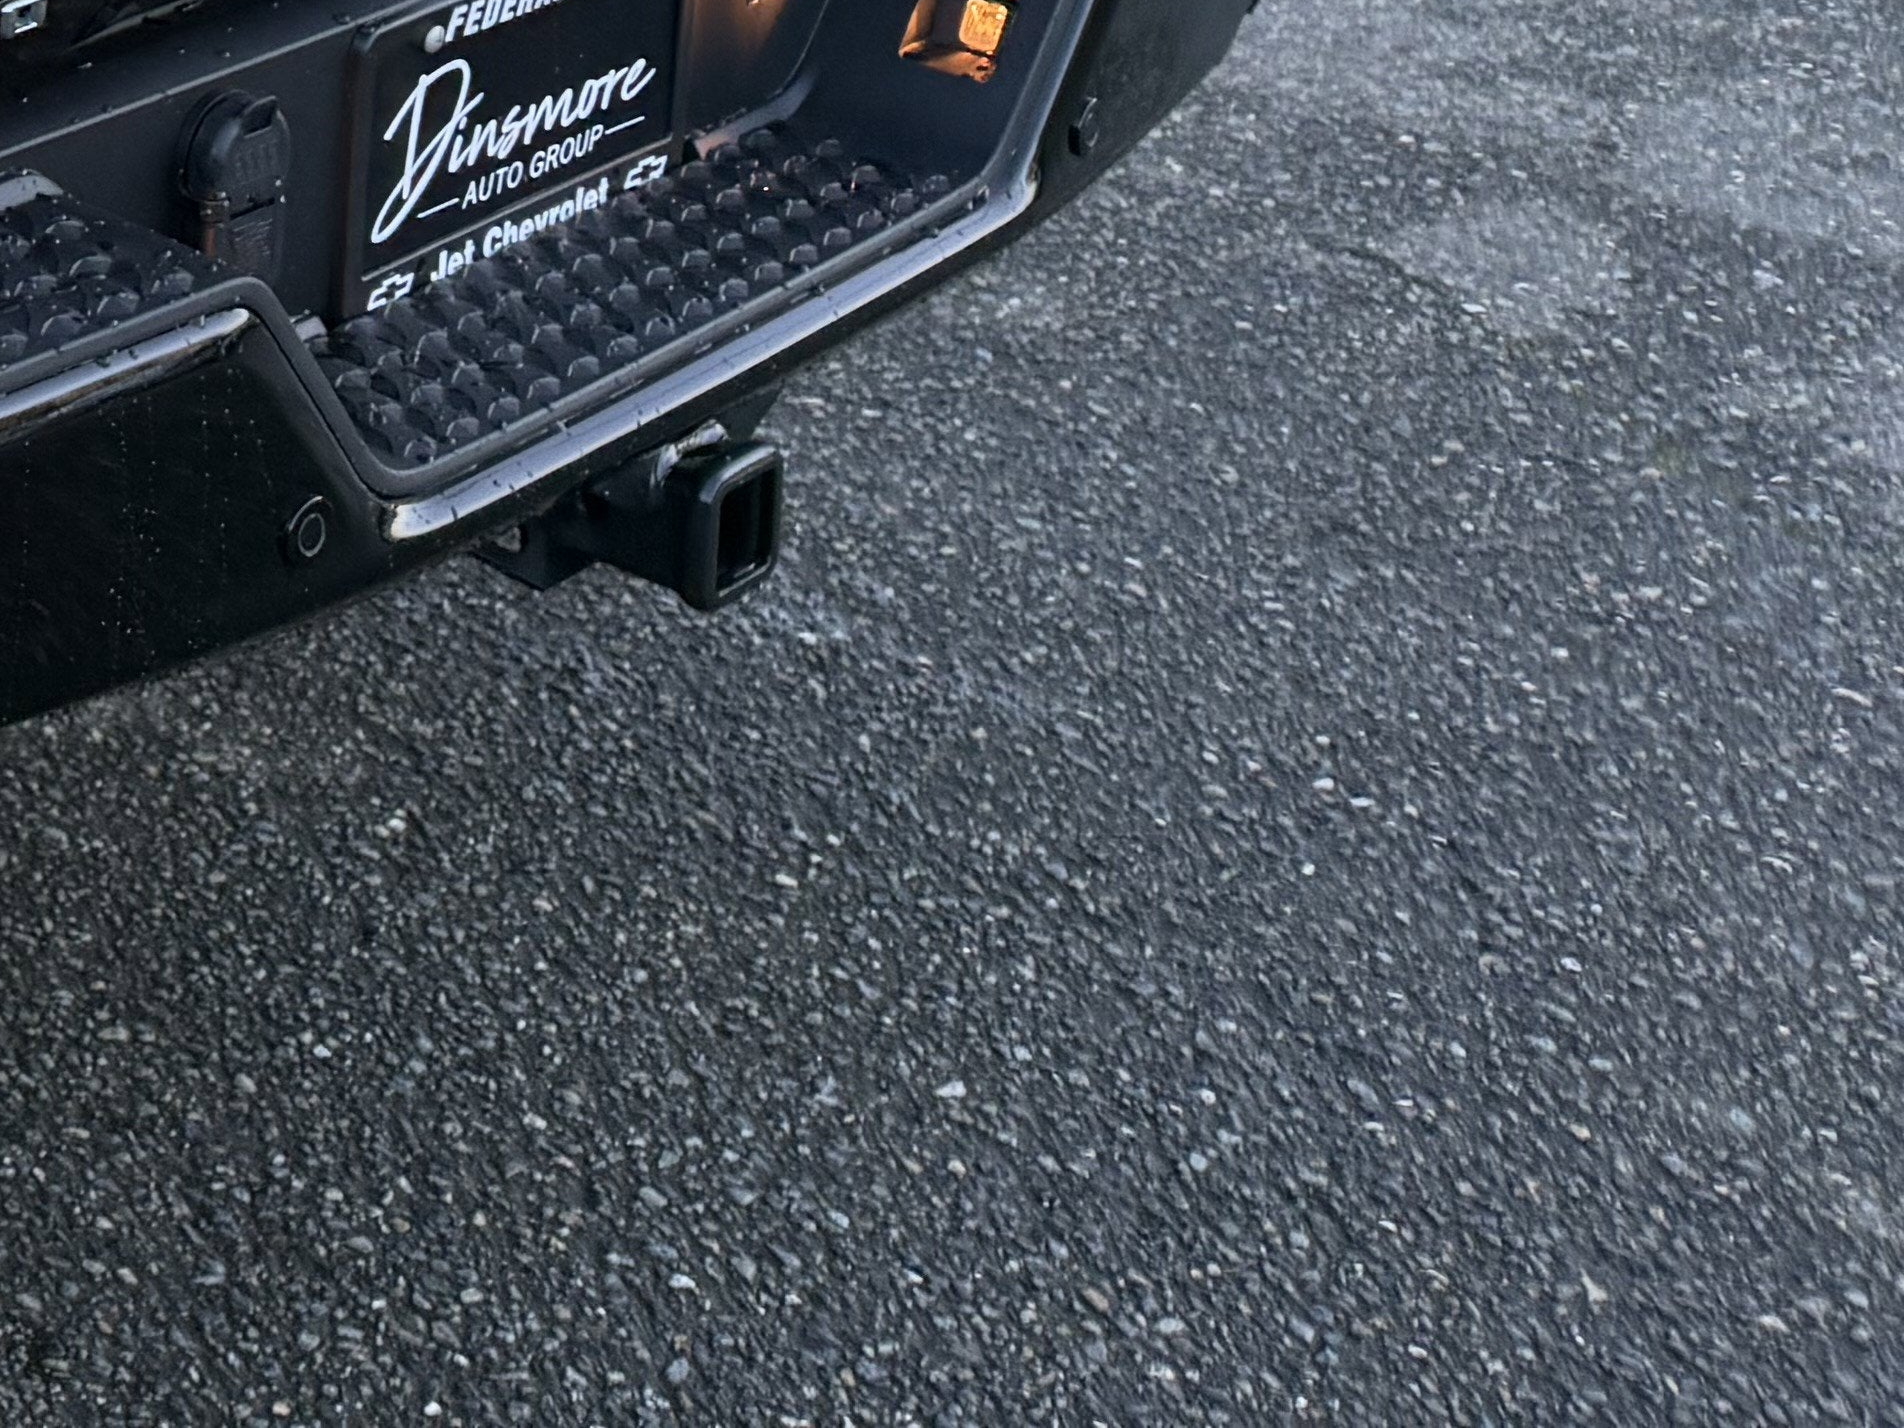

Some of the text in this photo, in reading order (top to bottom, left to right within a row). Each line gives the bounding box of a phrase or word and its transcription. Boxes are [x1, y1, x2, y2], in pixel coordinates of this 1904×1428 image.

[370, 58, 656, 244] Dinsmore
[461, 123, 605, 210] AUTO GROUP
[430, 176, 609, 282] Jet Chevrolet
